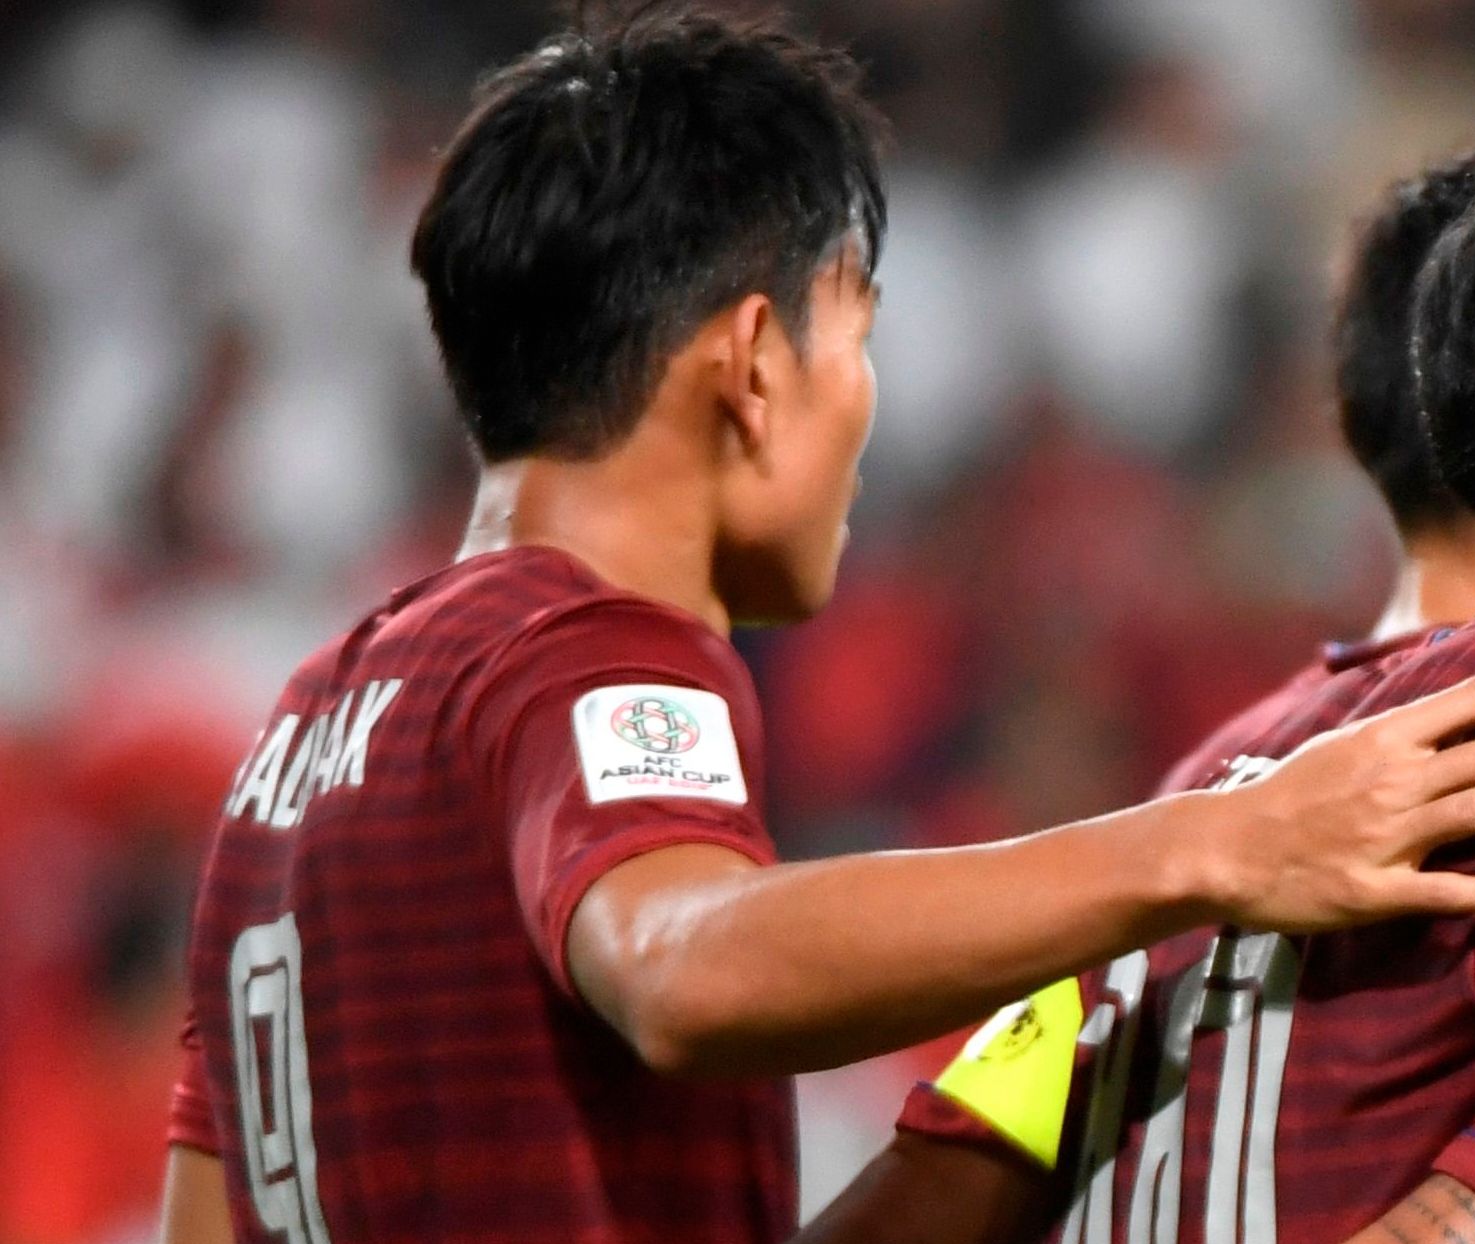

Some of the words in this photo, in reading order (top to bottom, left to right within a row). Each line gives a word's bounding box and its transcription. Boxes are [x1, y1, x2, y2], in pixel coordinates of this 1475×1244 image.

[644, 755, 682, 768] AFC
[600, 765, 674, 781] ASIAN
[682, 770, 731, 784] CUP
